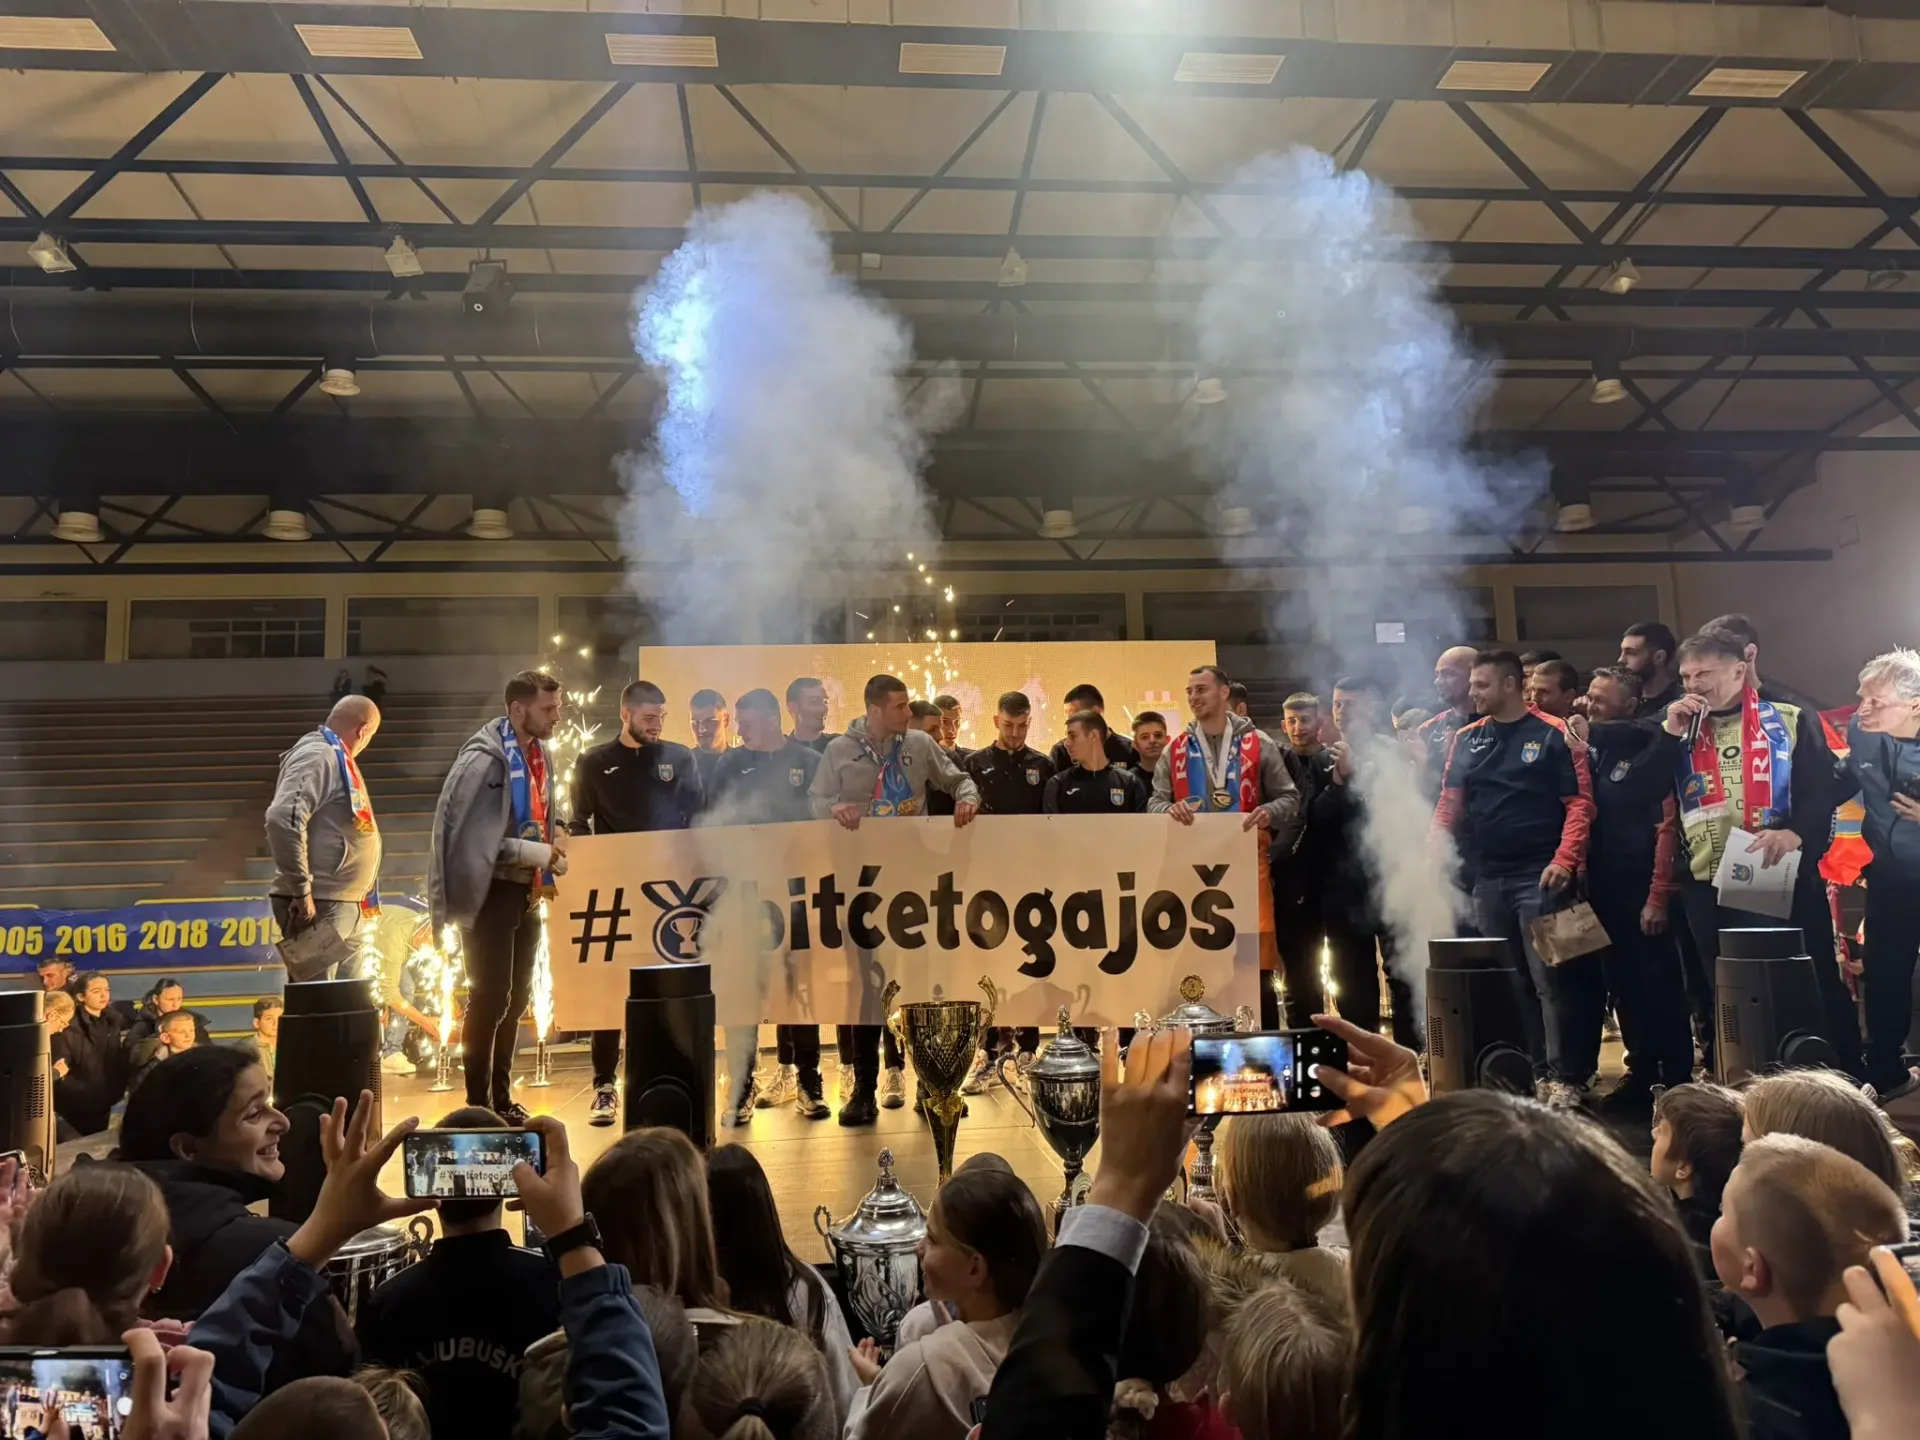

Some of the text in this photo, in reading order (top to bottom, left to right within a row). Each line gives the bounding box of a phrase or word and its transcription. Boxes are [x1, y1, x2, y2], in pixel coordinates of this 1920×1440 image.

[55, 922, 127, 954] 2016
[139, 918, 209, 950] 2018
[414, 1336, 526, 1380] LJUBUŠK
